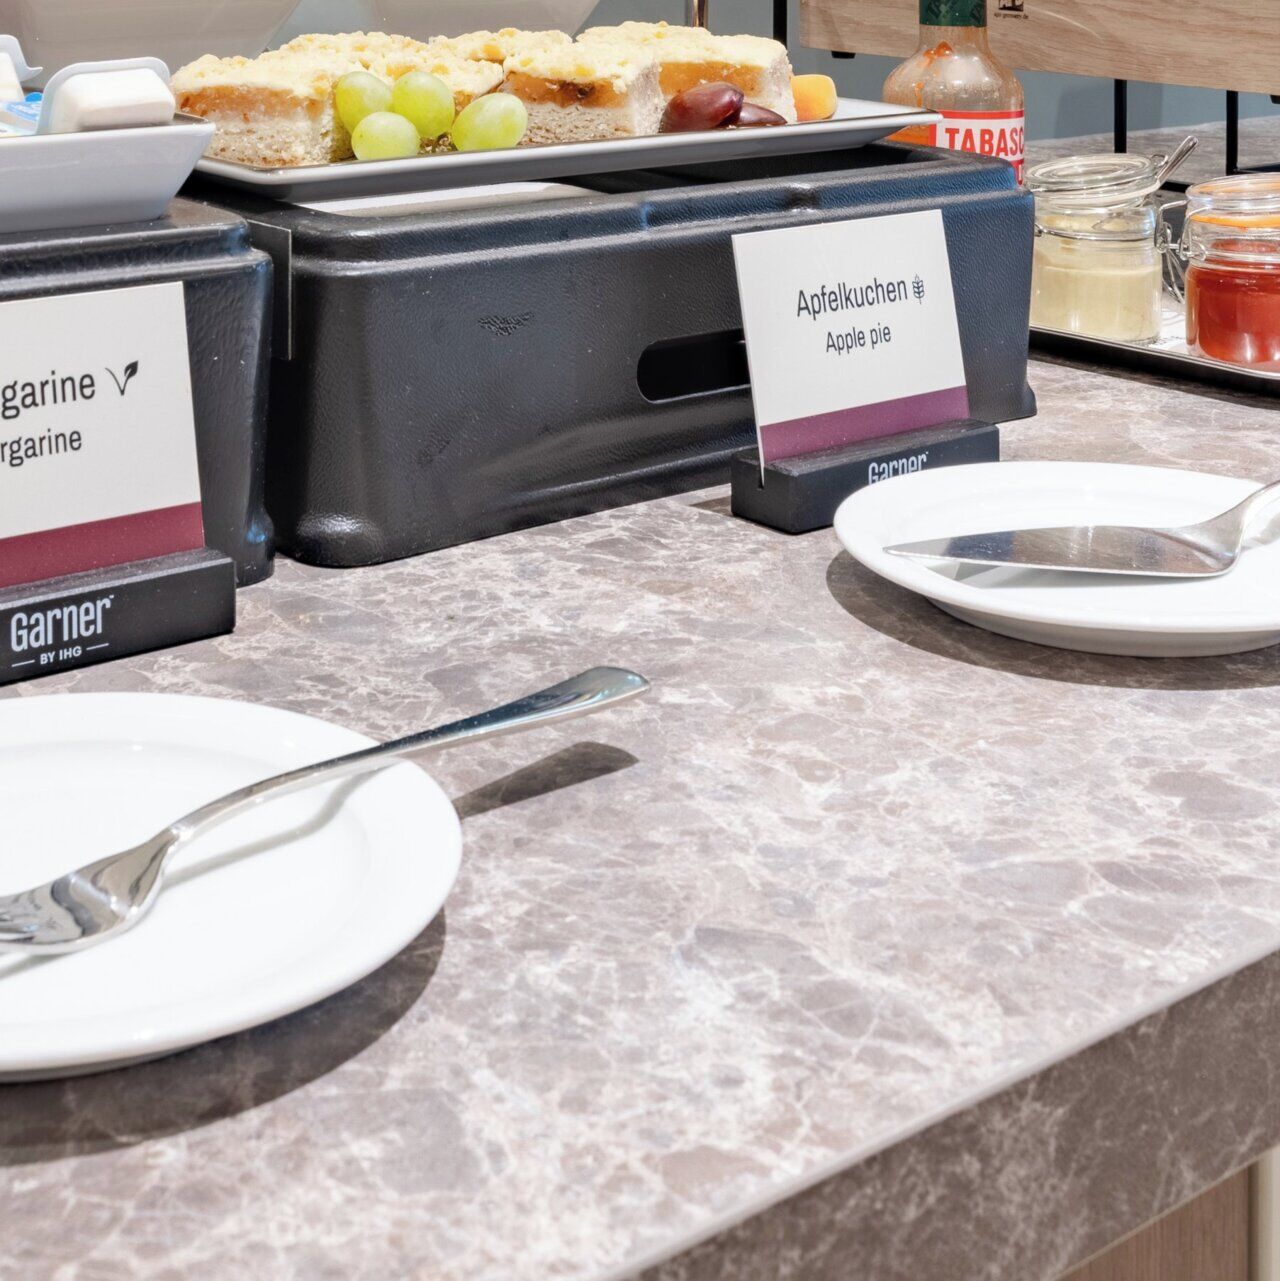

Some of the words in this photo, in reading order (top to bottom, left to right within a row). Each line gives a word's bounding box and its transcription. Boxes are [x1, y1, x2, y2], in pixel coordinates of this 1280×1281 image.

[796, 277, 908, 321] Apfelkuchen
[826, 326, 866, 356] Apple
[870, 322, 892, 350] pie
[10, 598, 111, 653] Garner
[39, 652, 55, 665] BY
[59, 646, 82, 662] IHG
